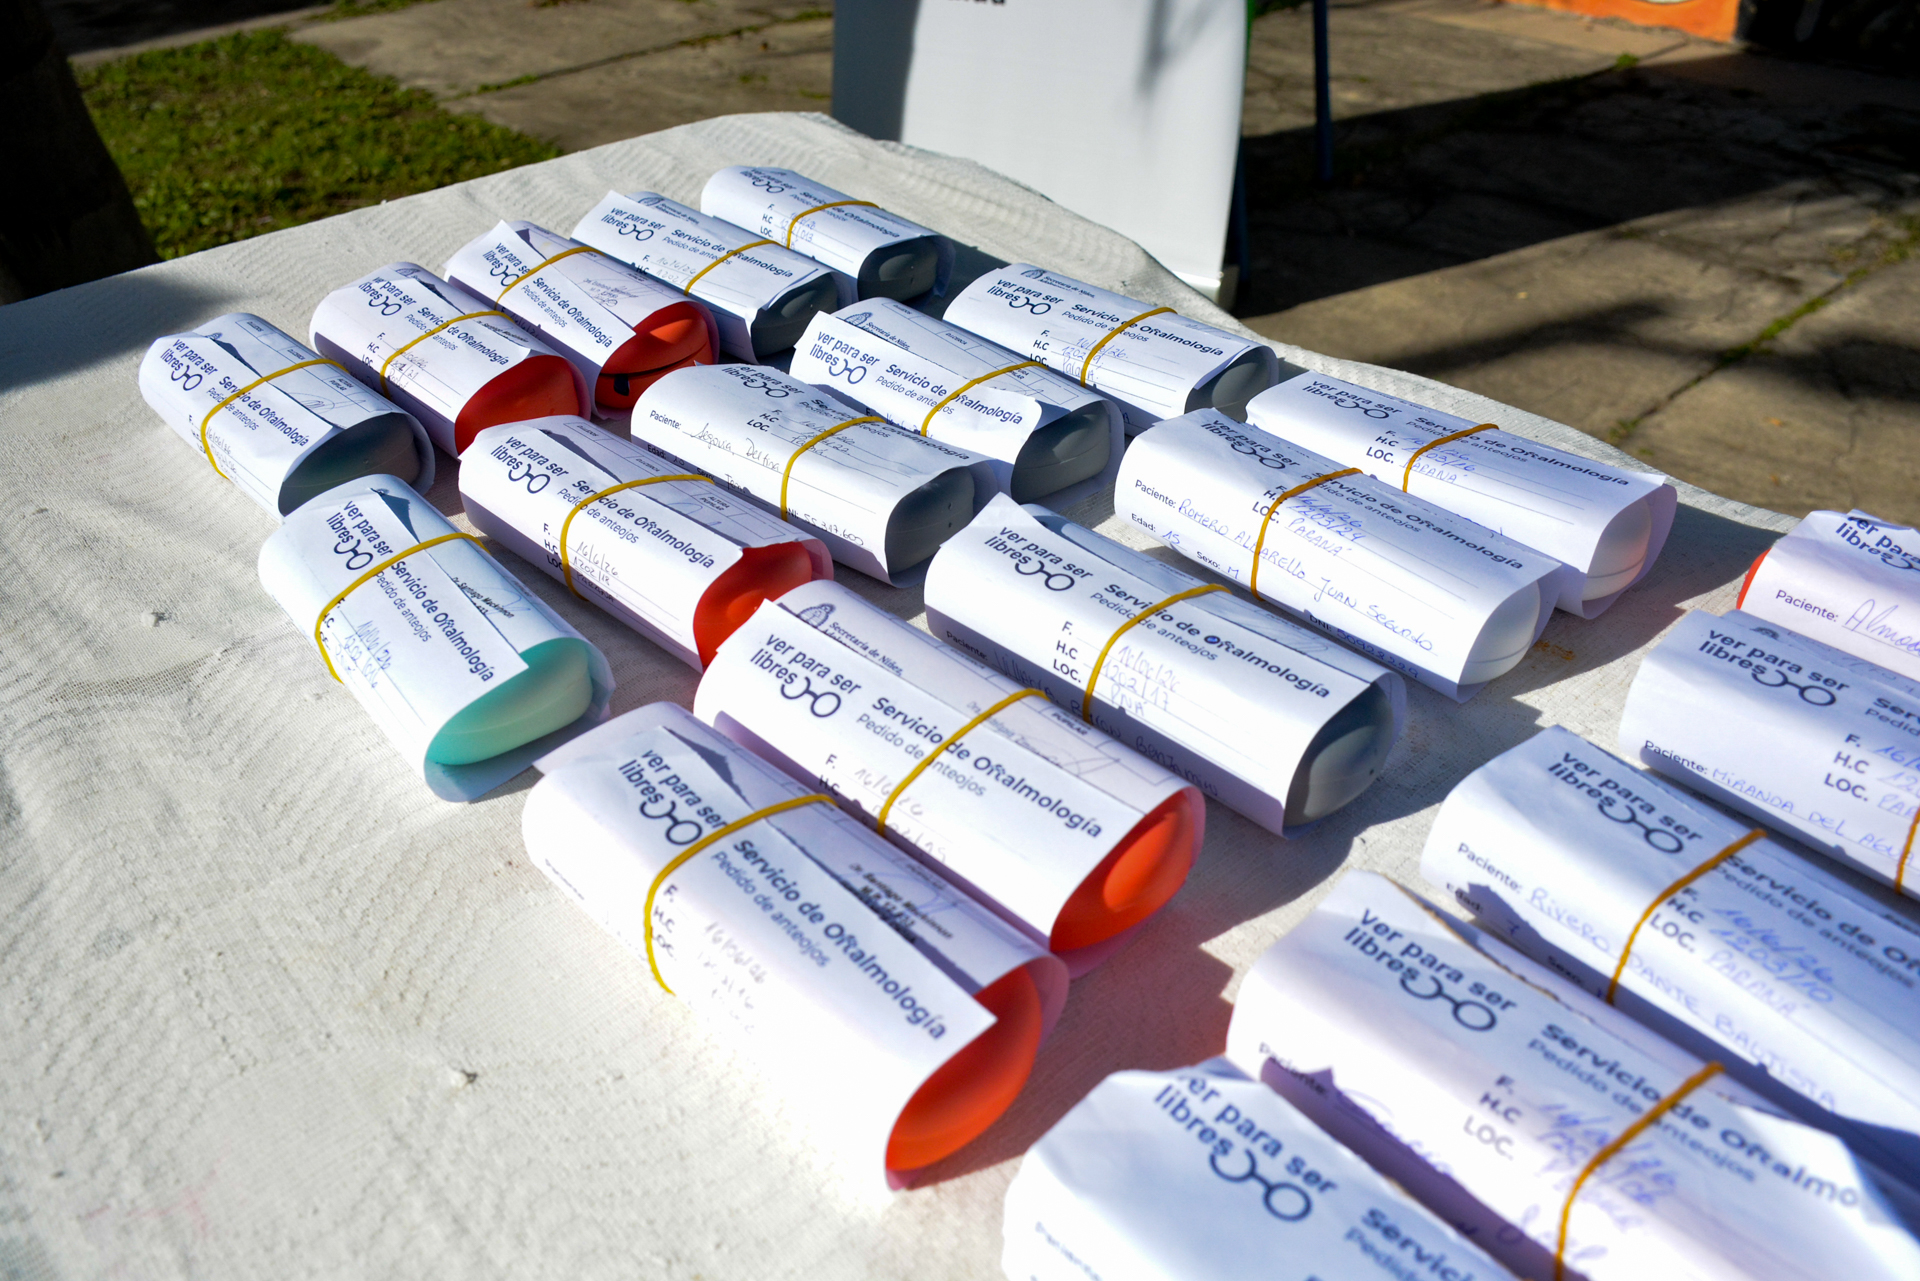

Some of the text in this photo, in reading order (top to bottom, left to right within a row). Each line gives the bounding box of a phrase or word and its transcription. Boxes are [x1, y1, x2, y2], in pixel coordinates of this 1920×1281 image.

[601, 214, 628, 231] libres
[610, 207, 666, 230] ver para ser
[844, 212, 901, 238] Oftalmología
[495, 242, 522, 269] ver para
[662, 236, 688, 250] Pedido
[671, 229, 711, 248] Servicio
[483, 250, 503, 269] libres
[359, 282, 382, 300] libres
[380, 281, 417, 306] para ser
[521, 285, 568, 328] Pedido anteojos
[987, 285, 1020, 302] libres
[996, 279, 1064, 304] ver para ser
[533, 277, 561, 302] Servicio
[566, 307, 613, 348] Oftalmología
[1061, 310, 1093, 327] Pedido
[1071, 303, 1224, 356] Servicio Oftalmología
[405, 314, 458, 351] Pedido anteojos
[457, 332, 508, 365] Oftalmología
[818, 331, 880, 366] ver para ser
[1033, 339, 1049, 352] H.C
[160, 349, 183, 371] libres
[173, 339, 218, 375] ver para ser
[809, 344, 838, 367] libres
[721, 367, 755, 388] libres
[752, 368, 804, 396] para ser
[875, 375, 903, 394] Pedido
[886, 364, 947, 397] Servicio de
[1302, 386, 1347, 405] libres
[1312, 380, 1402, 415] ver para ser
[232, 408, 259, 431] anteojos
[259, 408, 309, 446] Oftalmología
[650, 410, 682, 430] Paciente:
[746, 419, 769, 432] LOC.
[1201, 422, 1245, 453] libres
[1210, 419, 1300, 468] ver para ser
[1375, 435, 1399, 448] H.C
[1470, 440, 1529, 464] anteojos
[491, 445, 522, 470] libres
[505, 436, 569, 477] ver para ser
[1365, 446, 1395, 465] LOC.
[1511, 447, 1630, 487] Oftalmología
[1135, 478, 1177, 510] Paciente:
[327, 513, 354, 544] libres
[343, 500, 393, 557] ver para ser
[599, 517, 640, 545] anteojos
[616, 505, 636, 520] de
[634, 517, 716, 569] Oftalmología
[1131, 513, 1156, 533] Edad:
[1363, 507, 1422, 534] anteojos
[984, 536, 1032, 564] libres
[1000, 526, 1093, 580] ver para ser
[1406, 515, 1524, 570] Oftalmología
[1836, 522, 1894, 560] libres
[1196, 550, 1222, 569] Sexo:
[390, 560, 494, 682] Servicio de Oftalmología
[1775, 589, 1840, 622] Paciente:
[402, 610, 432, 643] anteojos
[829, 622, 869, 651] Secretaría
[1091, 592, 1218, 660] Pedido anteojos
[1309, 613, 1337, 634] DNI:
[750, 648, 798, 686] libres
[766, 633, 862, 696] ver para ser
[1056, 640, 1078, 660] H.C
[1176, 622, 1331, 700] de Oftalmología
[1698, 640, 1767, 676] libres
[1708, 629, 1850, 692] ver para ser
[1052, 658, 1082, 683] LOC.
[856, 713, 924, 759] Pedido de
[872, 697, 943, 744] Servicio
[973, 756, 1103, 839] Oftalmología
[1644, 740, 1708, 776] Paciente:
[1833, 751, 1870, 774] H.C
[618, 760, 663, 805] libres
[640, 747, 701, 809] ver para
[1547, 761, 1617, 809] libres
[1823, 773, 1869, 802] LOC.
[1560, 751, 1704, 843] ver para ser
[1456, 842, 1522, 895] Paciente:
[710, 849, 832, 968] Pedido anteojos
[1723, 853, 1877, 949] Servicio de
[733, 839, 801, 904] Servicio
[798, 898, 825, 925] de
[824, 920, 948, 1040] Oftalmología
[1649, 911, 1697, 955] LOC.
[1343, 927, 1419, 983] libres
[1358, 908, 1518, 1014] ver para ser
[1816, 926, 1918, 990] anteojos
[1527, 1036, 1622, 1100] Pedido
[1540, 1022, 1662, 1103] Servicio
[1153, 1084, 1234, 1158] libres
[1480, 1090, 1522, 1126] H.C
[1215, 1098, 1283, 1159] para
[1284, 1152, 1338, 1196] ser
[1463, 1116, 1515, 1162] LOC.
